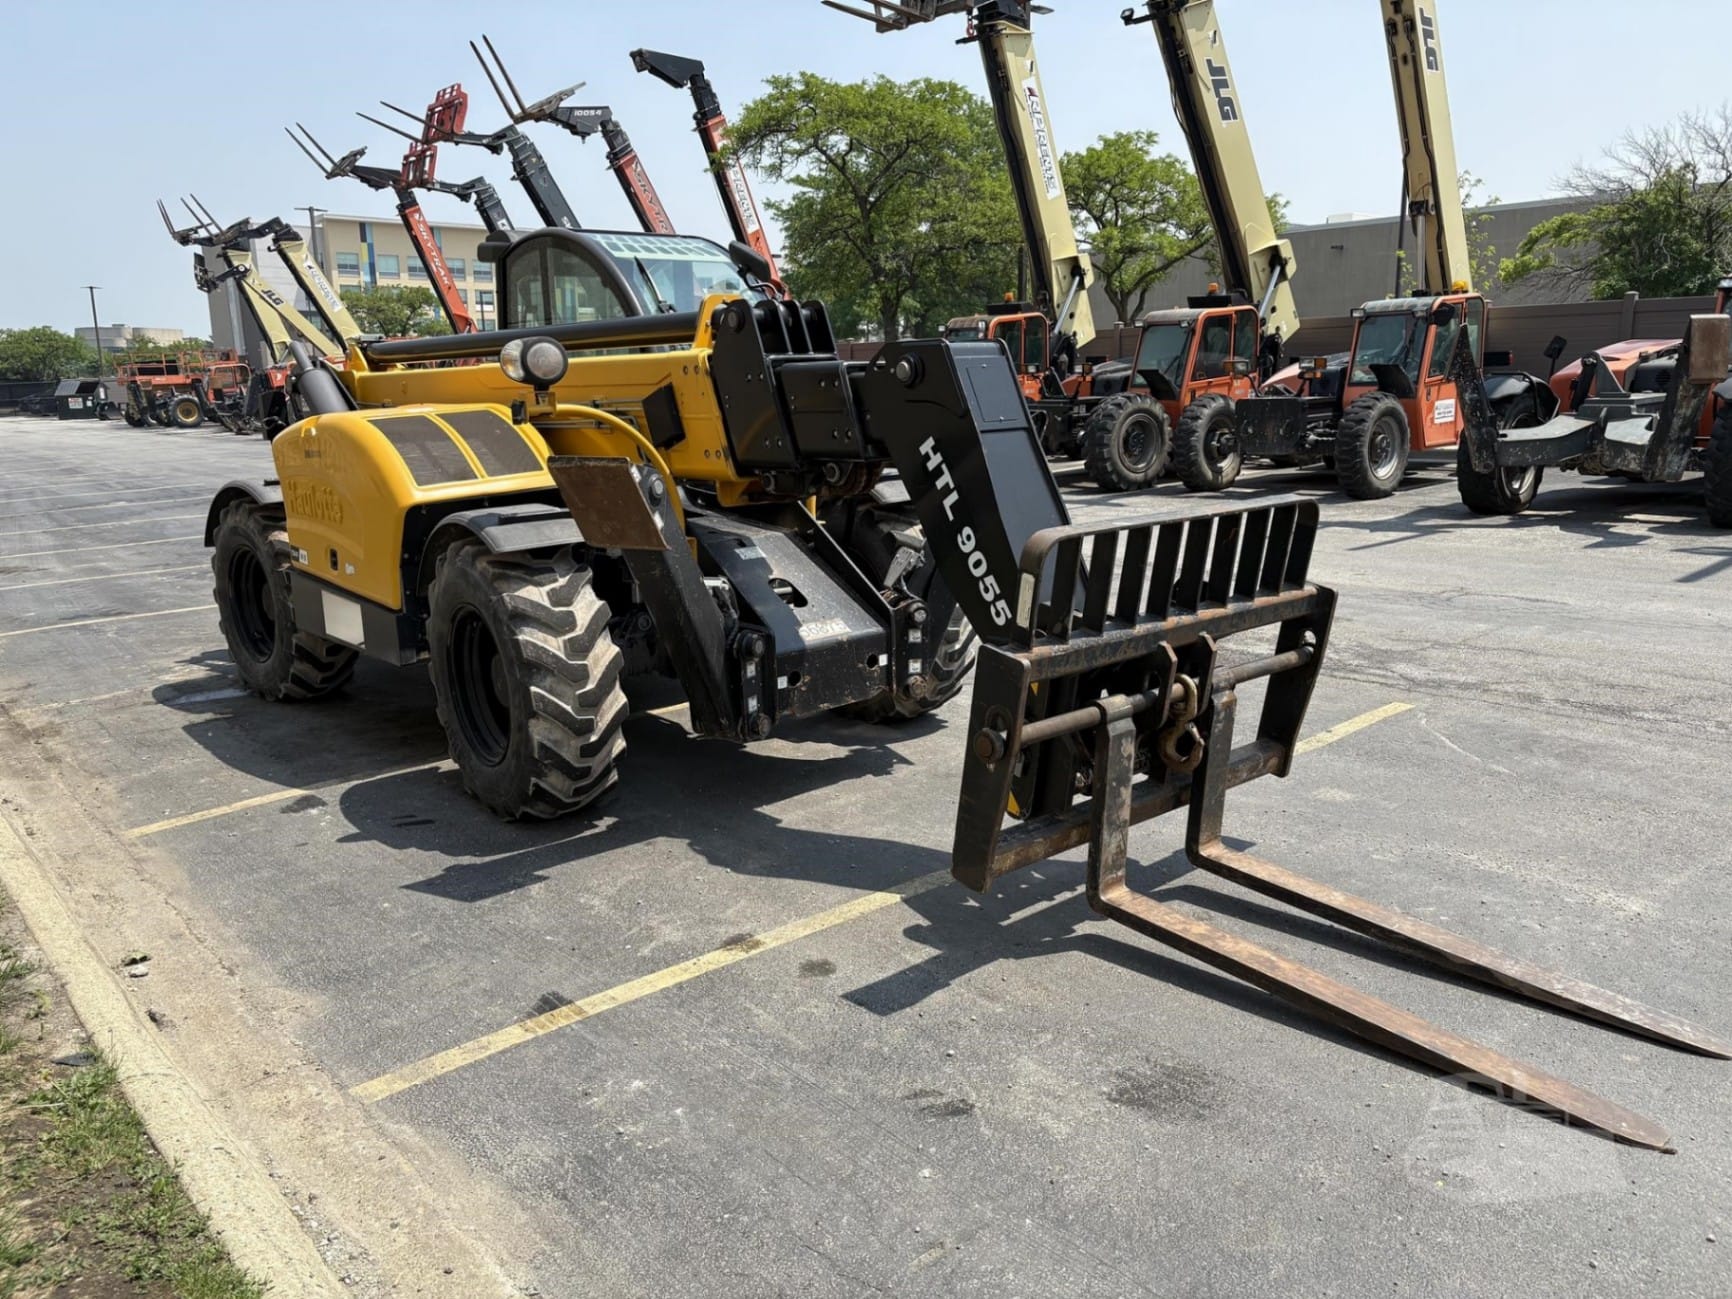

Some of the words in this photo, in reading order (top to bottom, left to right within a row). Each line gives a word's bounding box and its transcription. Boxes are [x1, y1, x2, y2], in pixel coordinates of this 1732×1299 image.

[1418, 7, 1439, 71] JLG
[1205, 58, 1238, 121] JLG
[417, 222, 450, 286] SKYTRAK
[261, 289, 284, 305] JLG
[919, 436, 959, 521] HTL
[957, 526, 1013, 626] 9055
